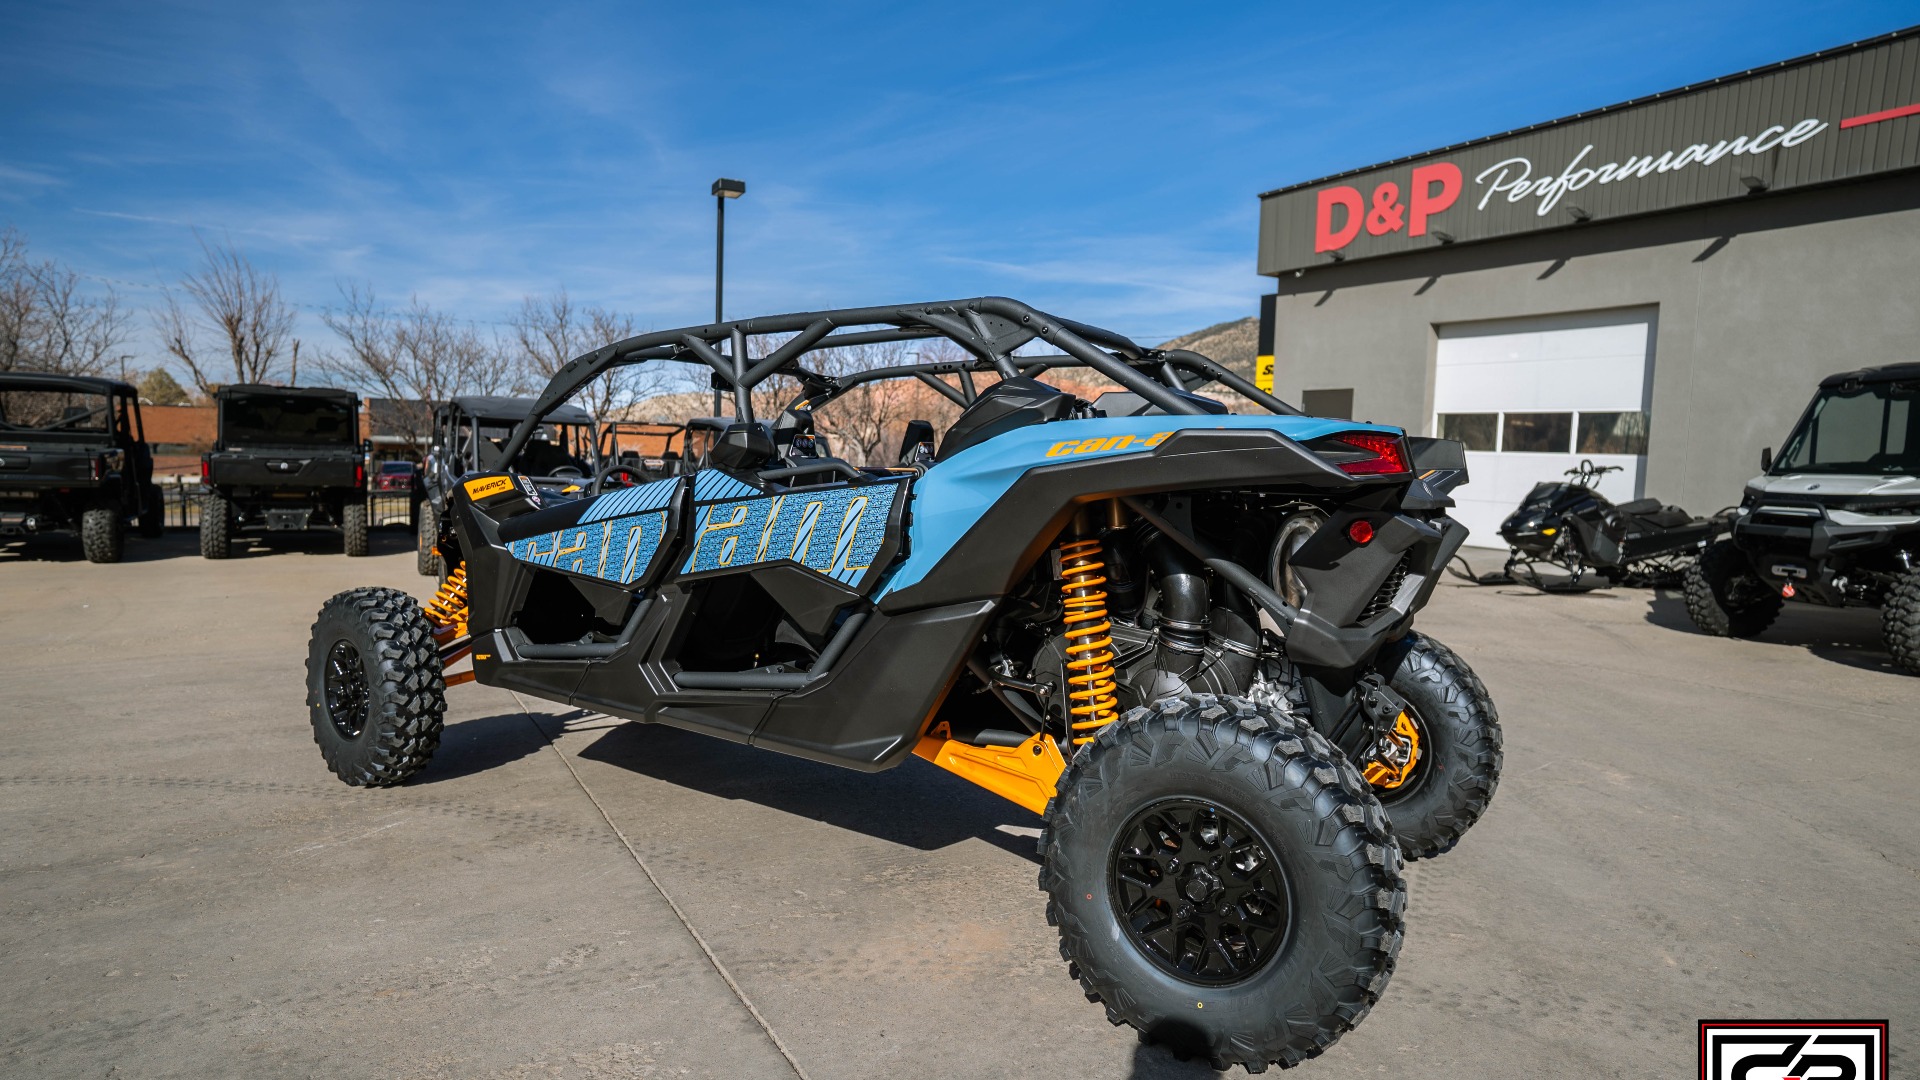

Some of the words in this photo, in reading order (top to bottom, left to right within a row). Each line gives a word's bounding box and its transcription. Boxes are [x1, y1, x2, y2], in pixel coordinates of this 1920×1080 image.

[1314, 162, 1464, 255] D&P
[1475, 118, 1830, 217] Performance
[472, 478, 507, 495] MAVERICK
